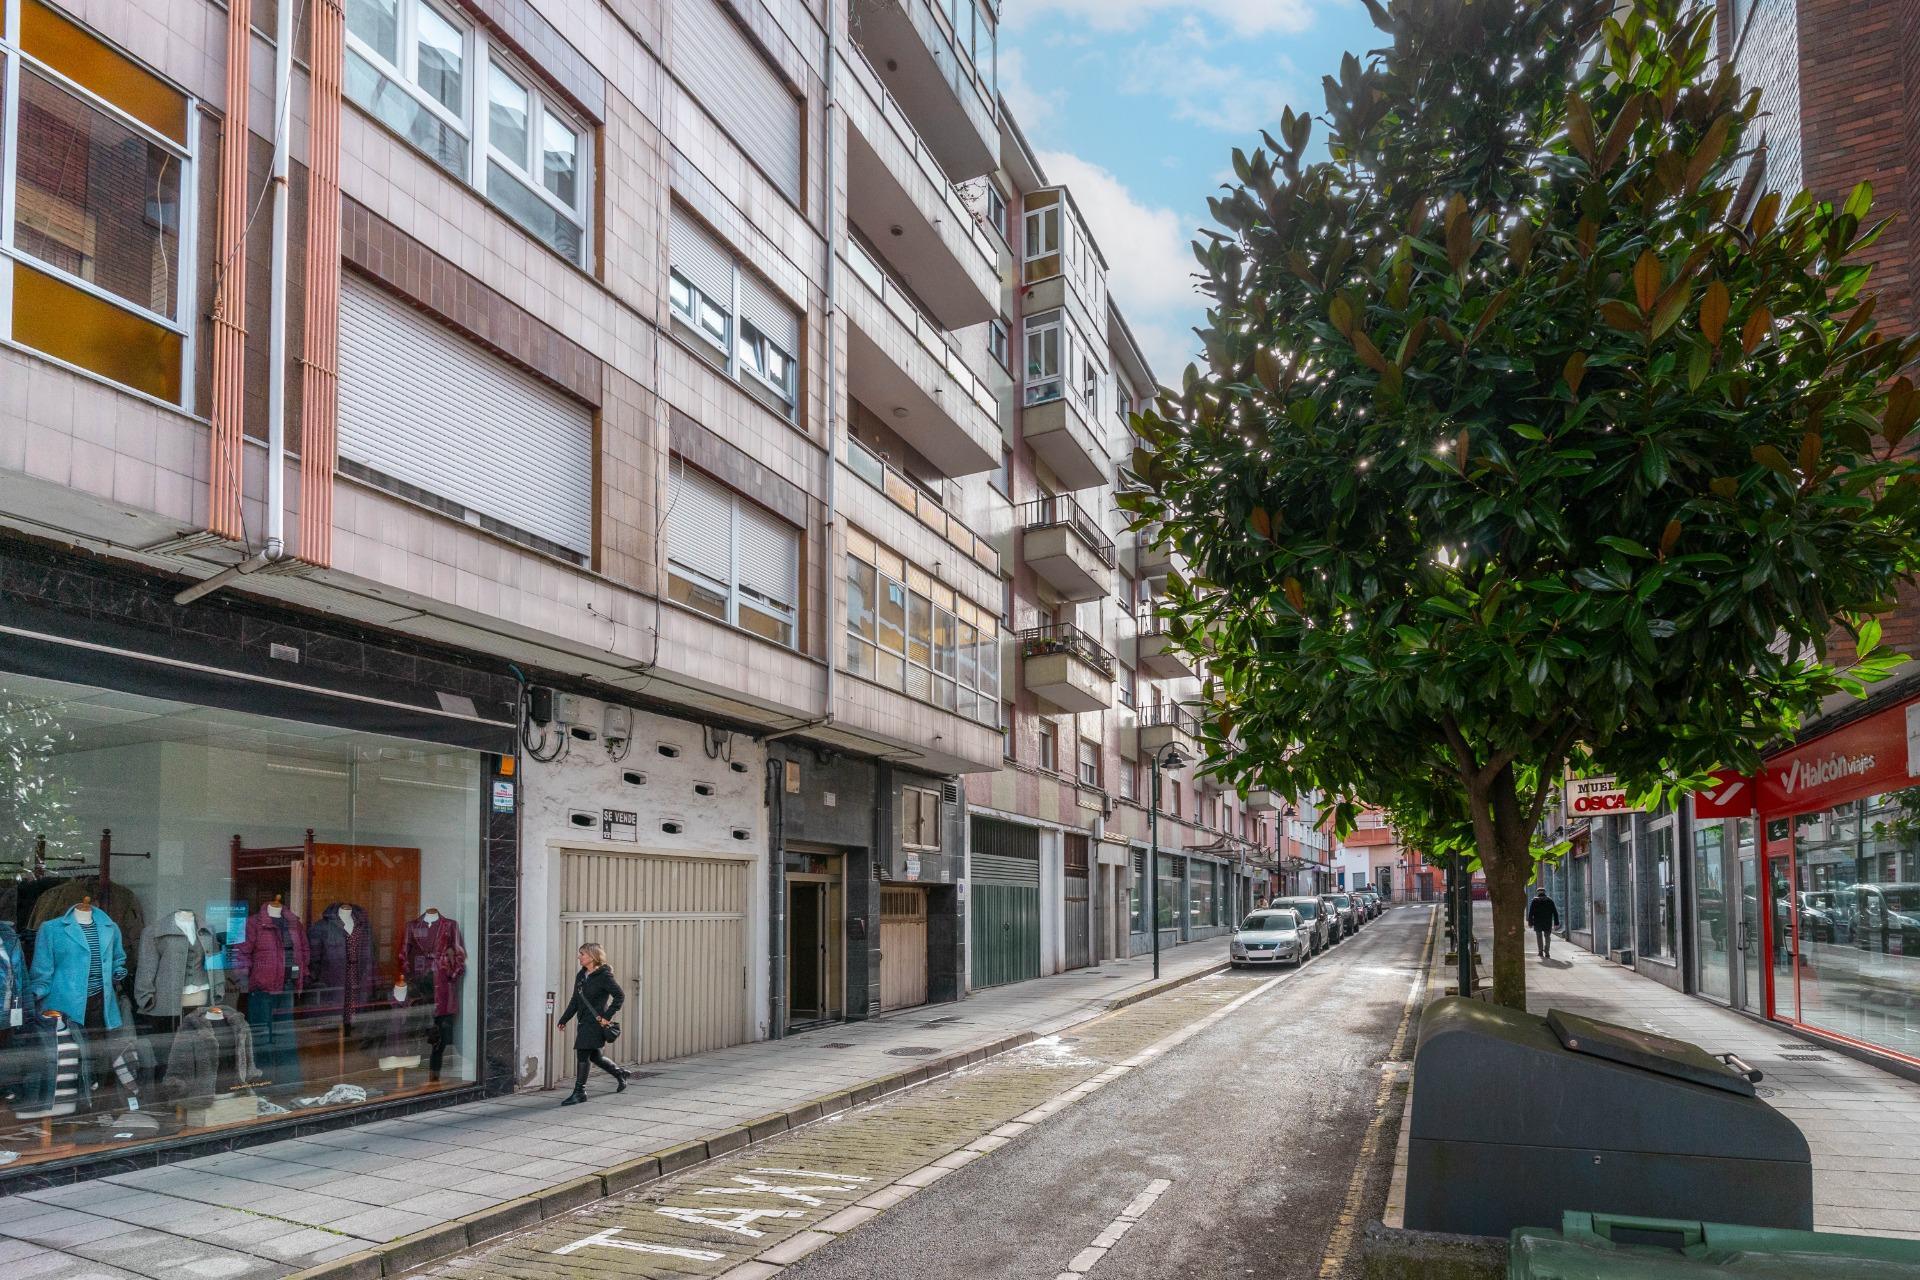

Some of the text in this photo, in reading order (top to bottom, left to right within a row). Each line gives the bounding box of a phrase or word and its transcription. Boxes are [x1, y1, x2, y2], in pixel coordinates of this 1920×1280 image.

[1800, 752, 1875, 790] Halcón viajes
[1574, 793, 1629, 812] OSCA
[603, 811, 636, 824] SE VENDE
[552, 1167, 875, 1262] TAXI
